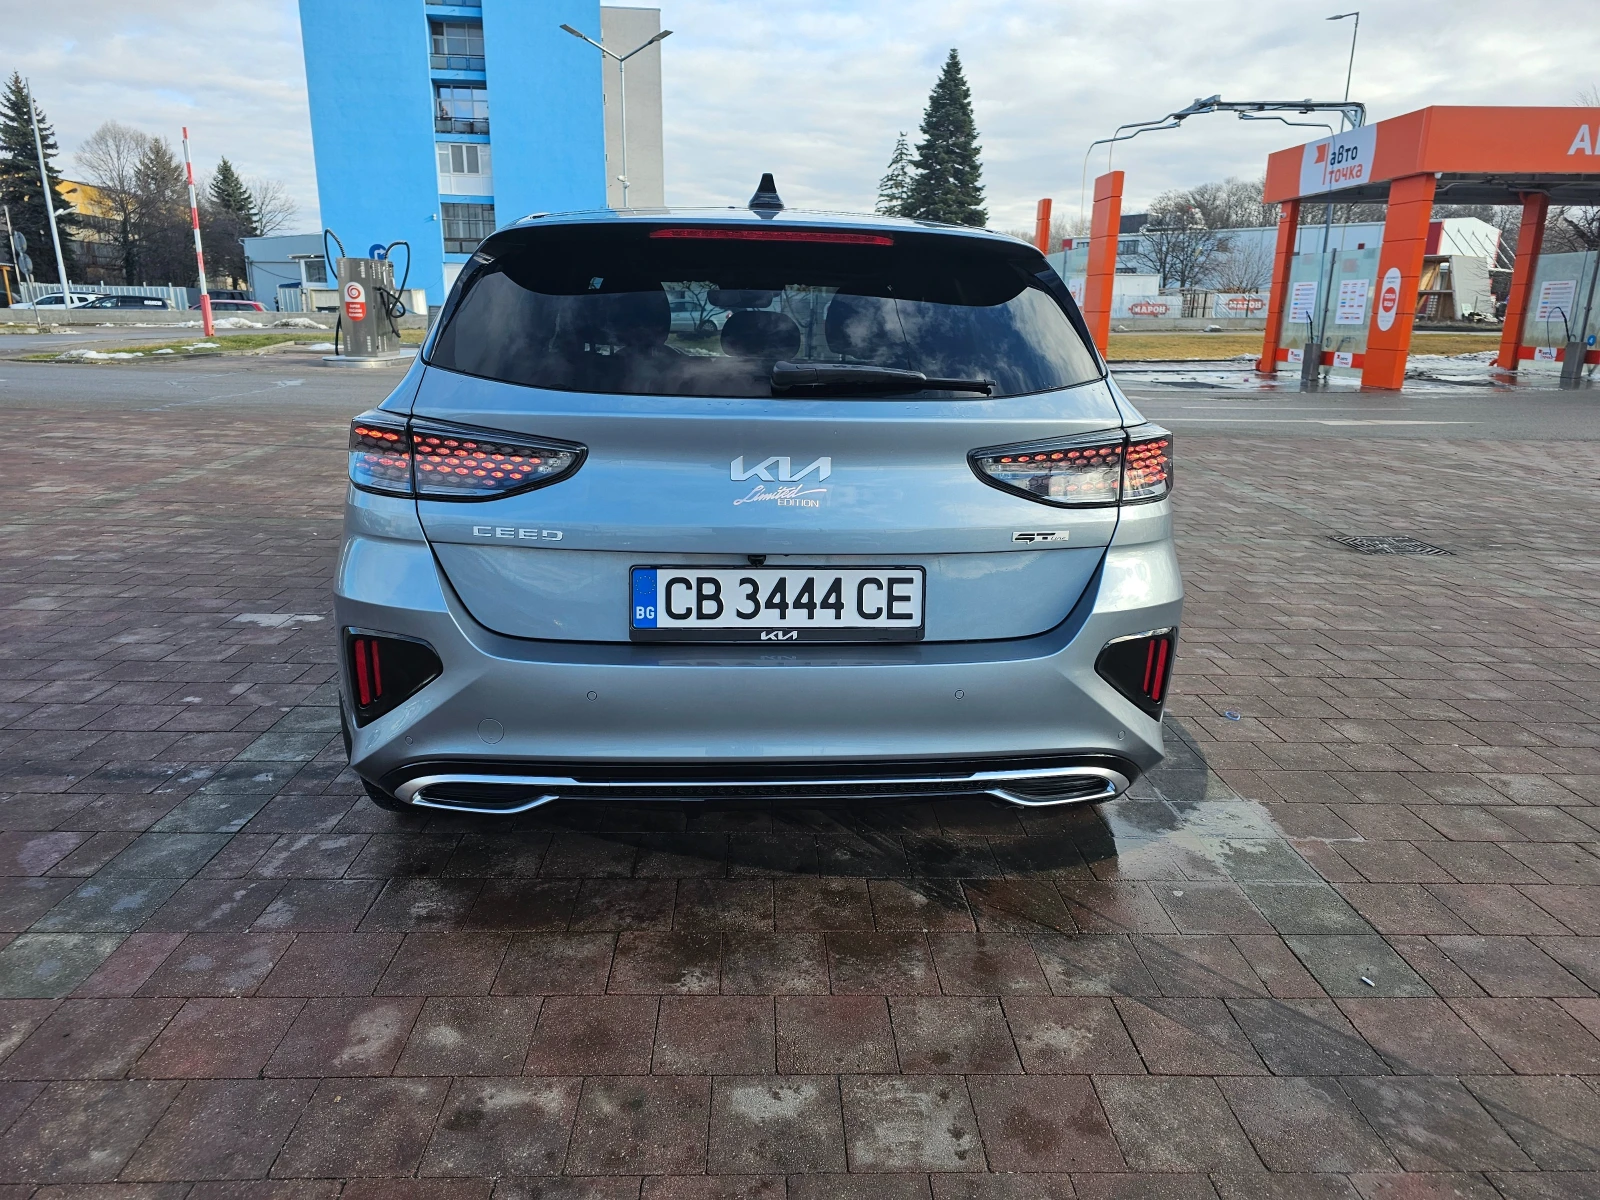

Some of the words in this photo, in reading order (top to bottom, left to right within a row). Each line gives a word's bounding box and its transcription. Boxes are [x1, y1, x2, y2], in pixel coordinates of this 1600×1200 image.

[1567, 123, 1600, 156] А
[1330, 144, 1358, 166] авто
[1328, 163, 1363, 184] точка
[1132, 305, 1166, 314] МАРОН
[1228, 300, 1262, 309] МАРОН
[730, 455, 832, 483] KIA
[733, 484, 827, 506] Limited
[777, 498, 819, 508] EDITION
[473, 525, 563, 541] CEED
[665, 576, 724, 620] CB
[735, 576, 845, 620] 3444
[856, 576, 914, 620] CE
[635, 606, 655, 620] BG
[760, 630, 798, 641] KIA
